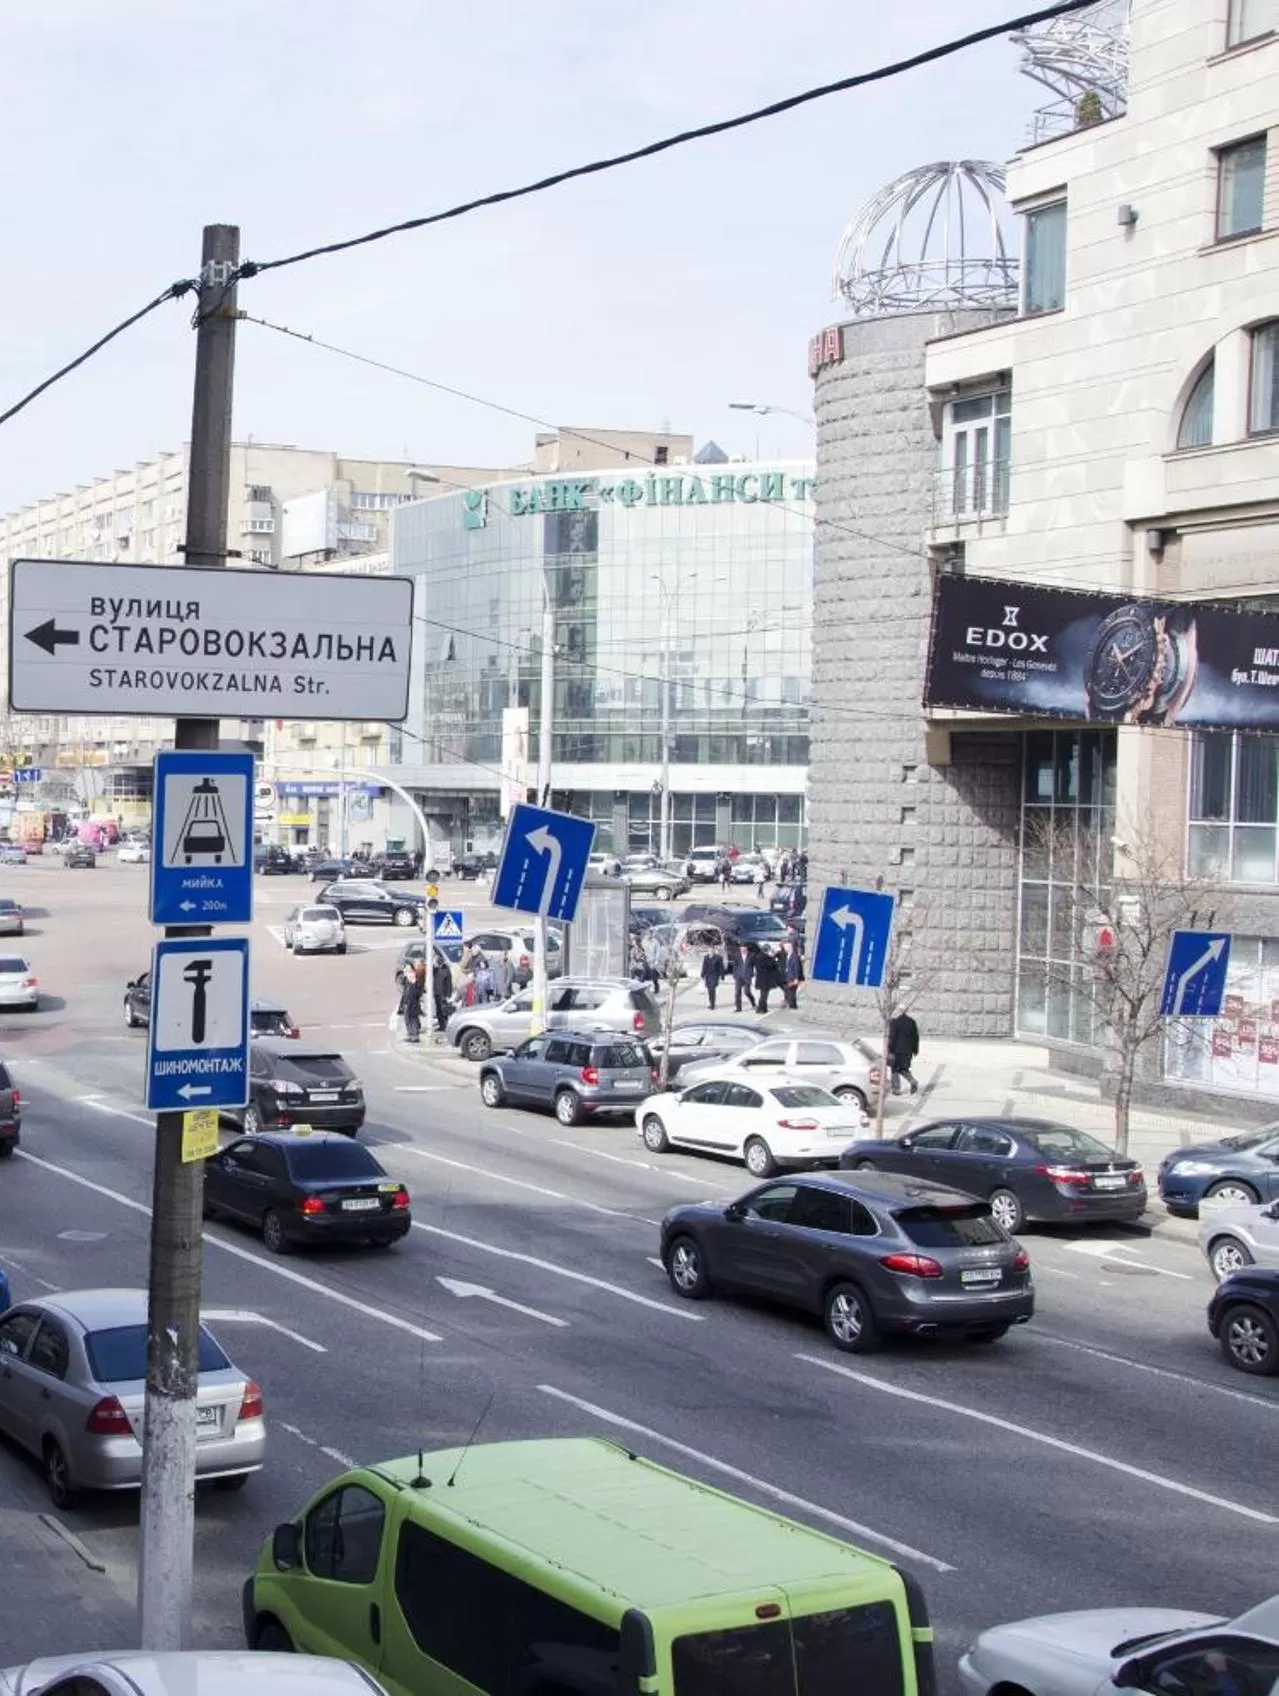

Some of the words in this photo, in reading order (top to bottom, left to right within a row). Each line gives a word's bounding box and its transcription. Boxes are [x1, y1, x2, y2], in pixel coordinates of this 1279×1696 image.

[509, 479, 591, 515] БАНК
[90, 596, 200, 623] вулиця
[89, 624, 397, 663] СТАРОВОКЗАЛЬНА
[966, 627, 1050, 653] EDOX
[1253, 647, 1279, 666] ШАТ
[89, 668, 282, 694] STAROVOKZALNA
[293, 674, 330, 696] Str.
[181, 875, 224, 889] МИЙКА
[154, 1058, 243, 1076] ШИНОМОНТАЖ
